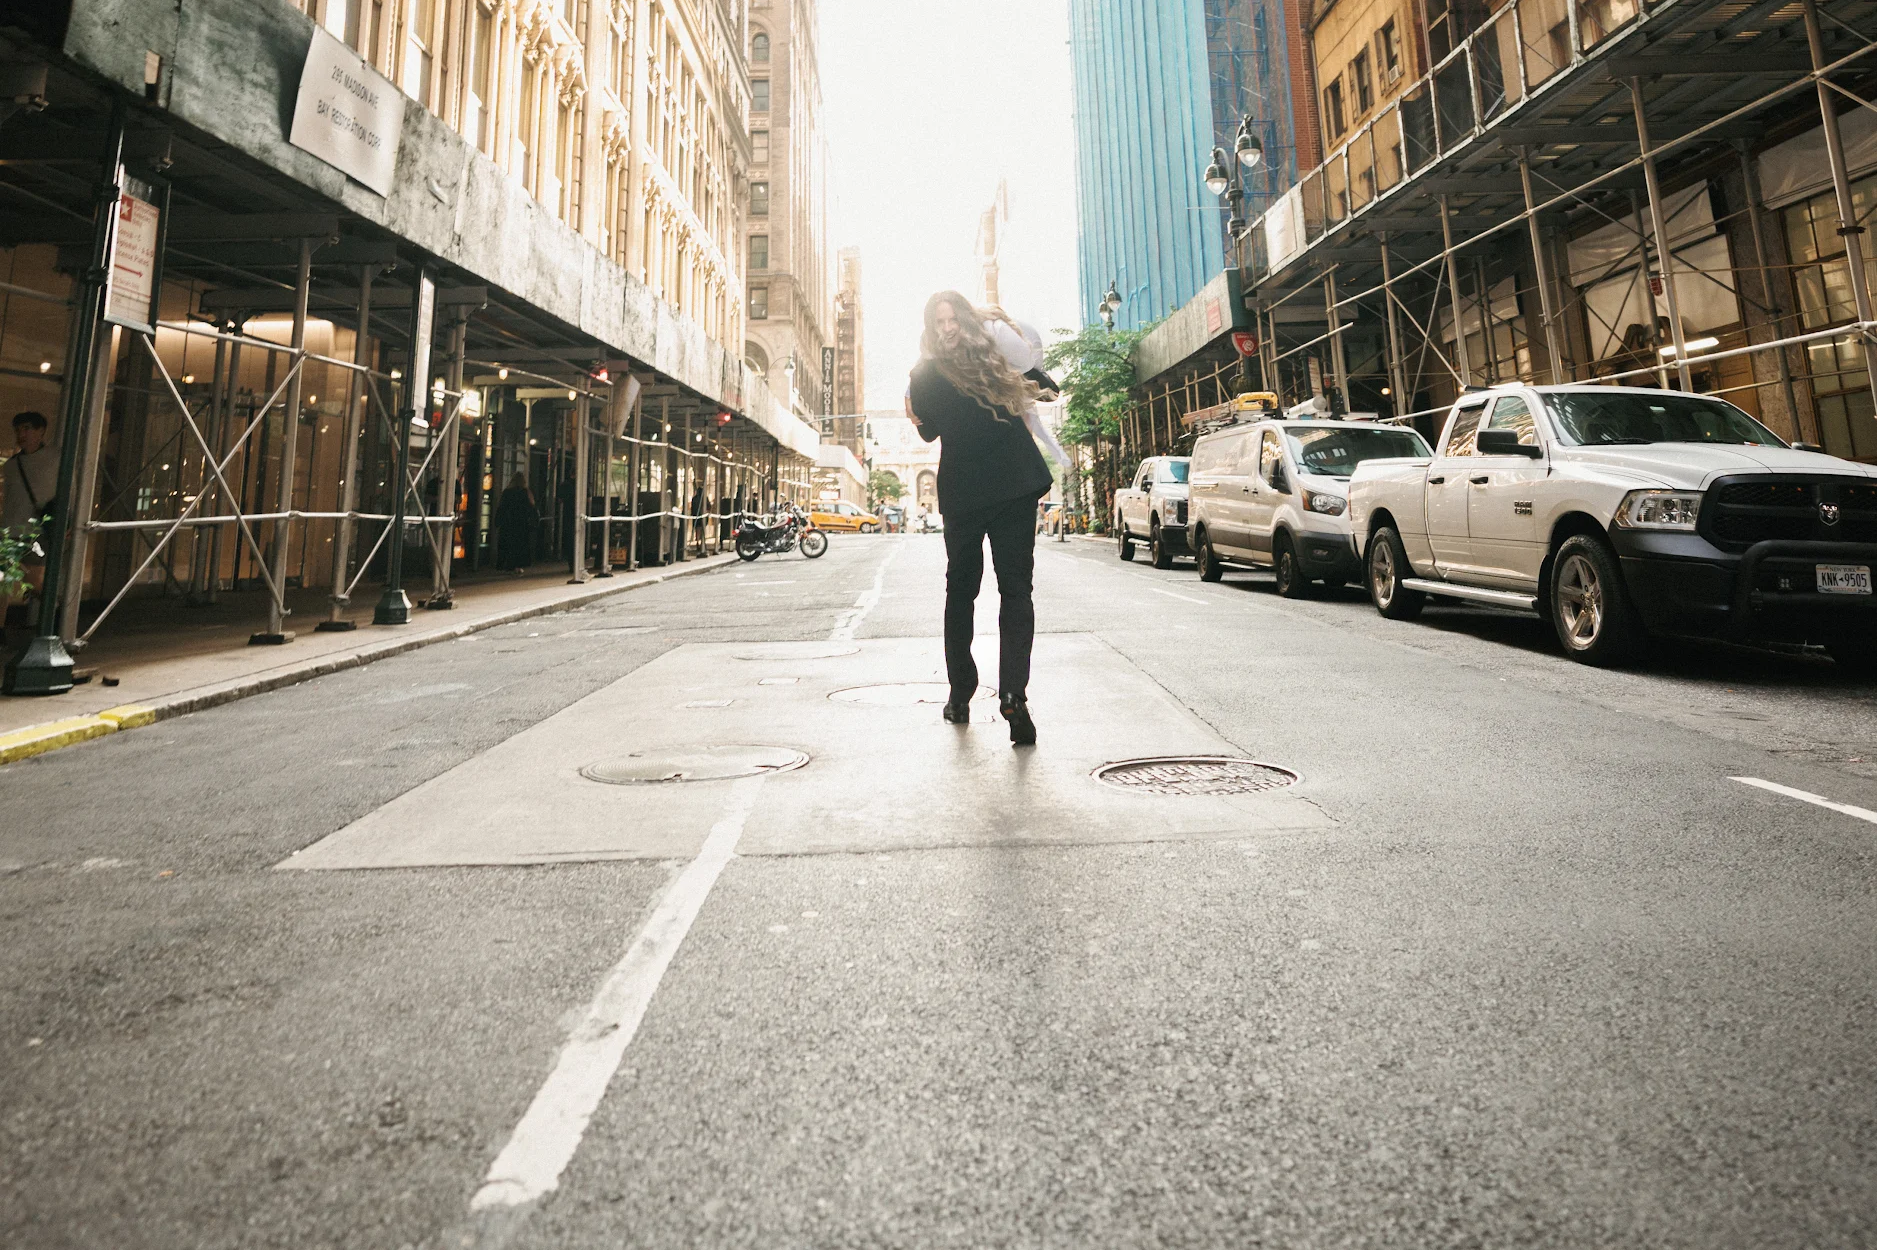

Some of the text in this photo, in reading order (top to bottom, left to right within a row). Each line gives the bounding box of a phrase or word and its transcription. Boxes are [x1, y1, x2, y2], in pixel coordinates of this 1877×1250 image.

[344, 74, 368, 102] MADISON
[368, 90, 380, 110] AVE
[316, 98, 330, 118] BAY
[823, 349, 832, 425] ANNIE MOORES
[1514, 500, 1532, 508] RAM
[1514, 507, 1532, 515] 1500
[1821, 572, 1868, 588] KNK 9505
